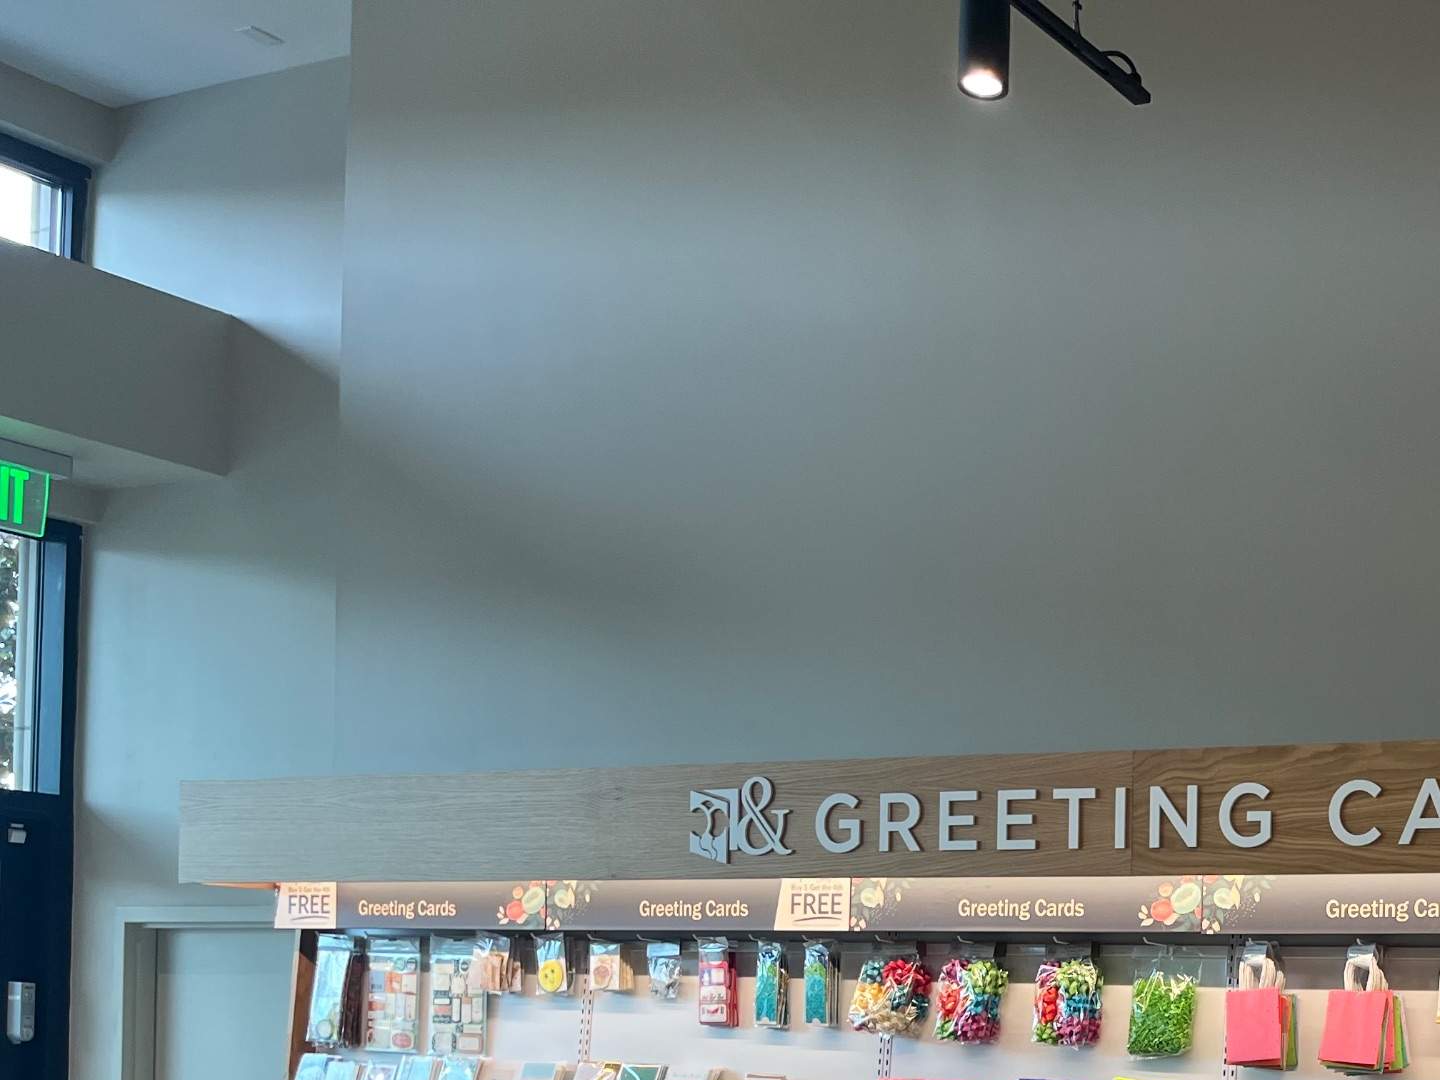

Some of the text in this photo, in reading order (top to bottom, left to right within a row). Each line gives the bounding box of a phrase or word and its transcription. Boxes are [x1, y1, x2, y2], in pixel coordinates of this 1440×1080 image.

[813, 782, 1275, 855] GREETING
[288, 894, 331, 914] FREE
[358, 900, 457, 919] Greeting Cards
[639, 900, 749, 920] Greeting Cards
[790, 893, 842, 914] FREE
[958, 898, 1085, 920] Greeting Cards
[1325, 899, 1409, 921] Greeting
